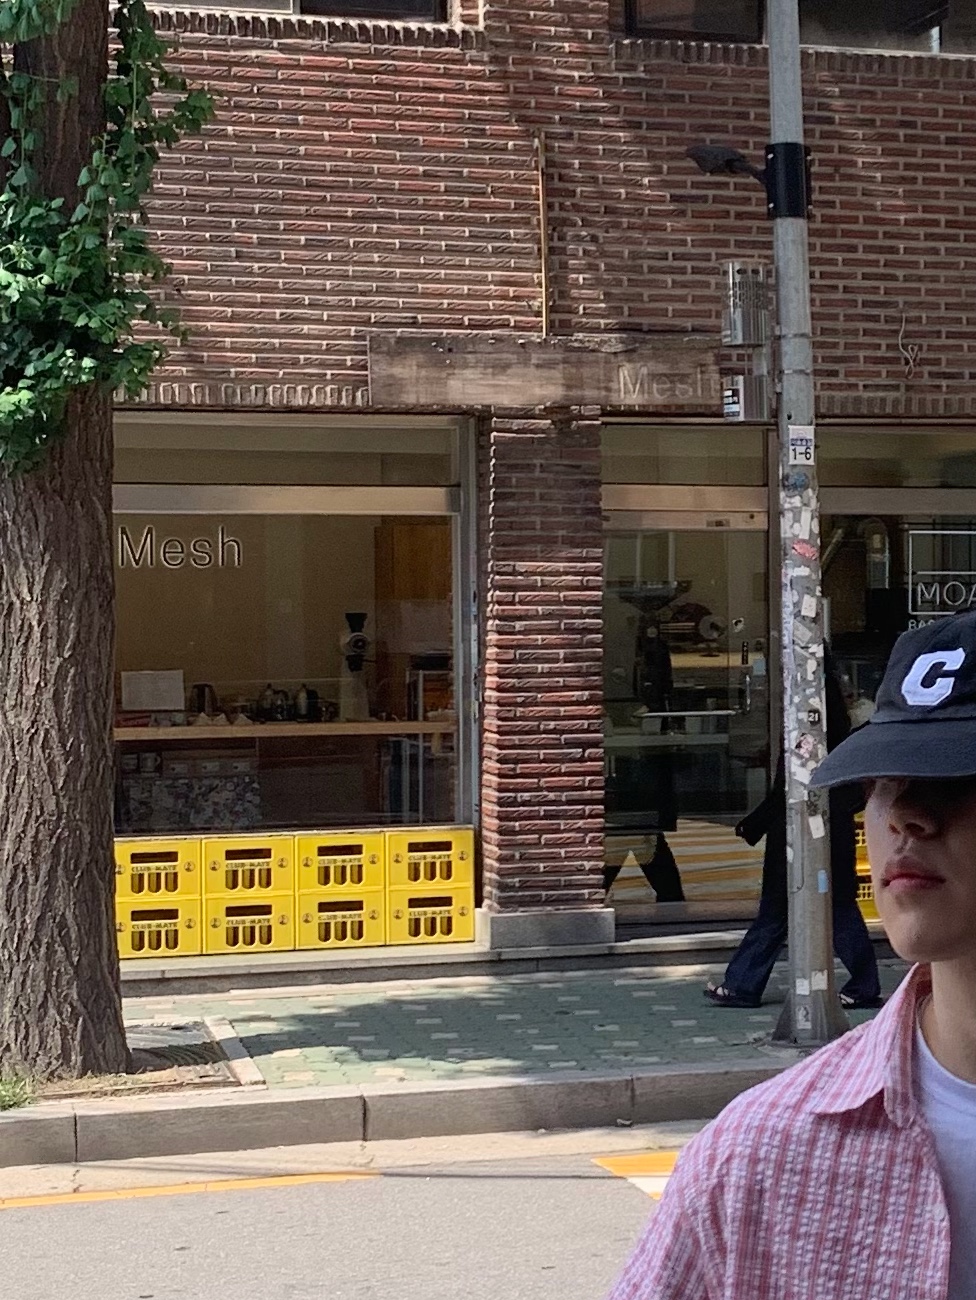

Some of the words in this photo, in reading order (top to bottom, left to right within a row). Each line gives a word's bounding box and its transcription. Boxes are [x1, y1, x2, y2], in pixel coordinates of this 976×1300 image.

[791, 446, 812, 461] 1-6
[118, 525, 242, 568] Mesh
[901, 647, 966, 706] C
